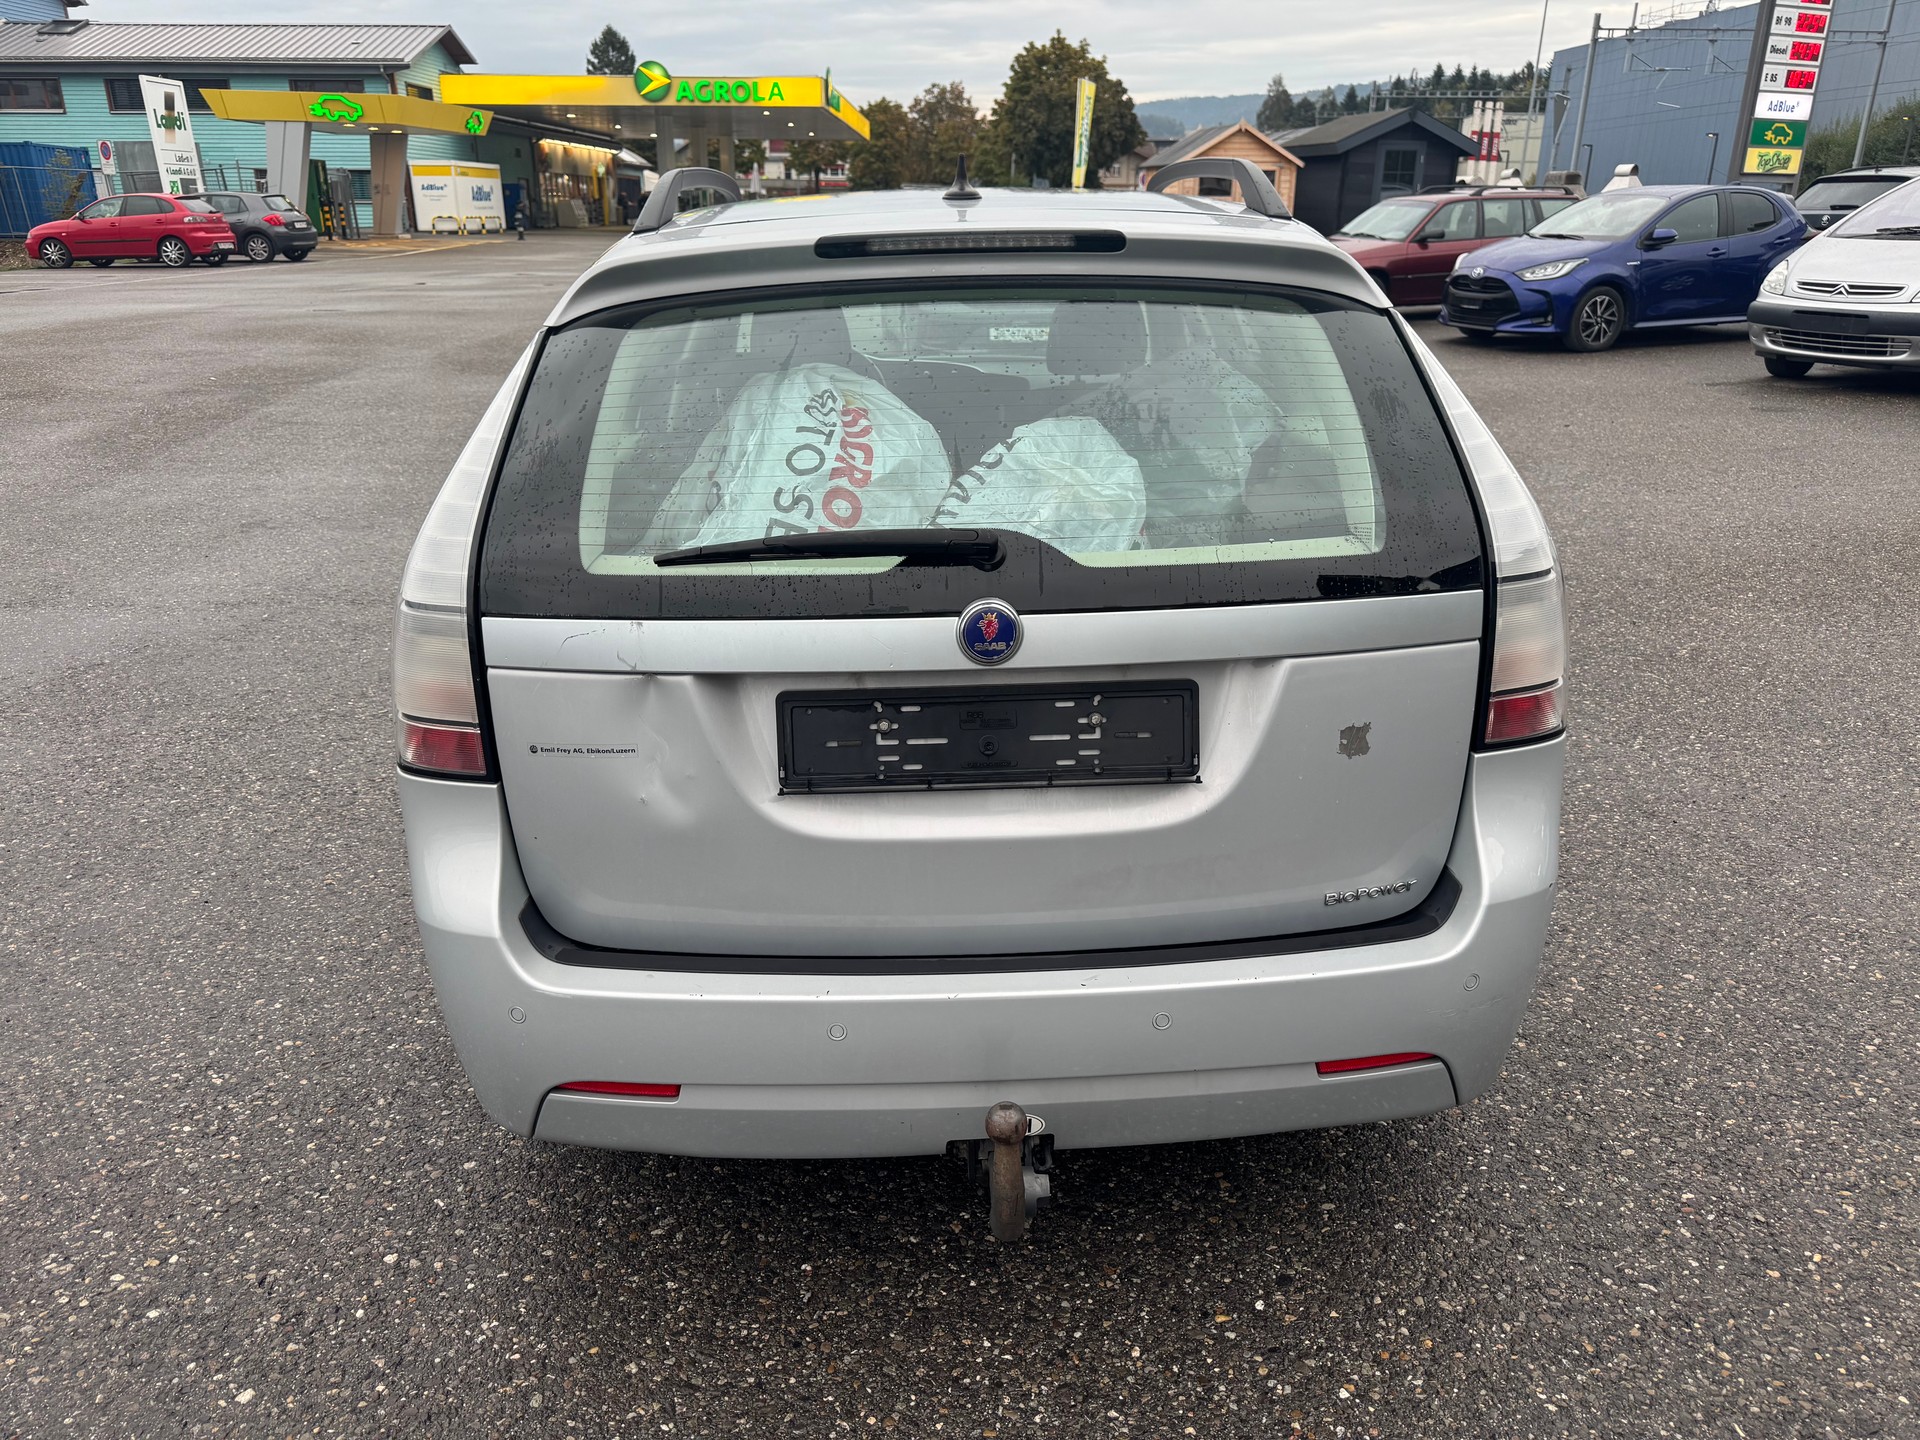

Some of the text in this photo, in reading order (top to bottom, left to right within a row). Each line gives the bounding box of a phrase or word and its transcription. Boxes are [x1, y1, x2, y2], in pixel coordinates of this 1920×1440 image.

[1784, 17, 1793, 26] 98
[1769, 44, 1788, 55] Diesel
[1764, 73, 1769, 82] E
[1769, 73, 1778, 83] 85
[676, 80, 785, 103] AGROLA
[974, 641, 1007, 651] SAAB
[556, 747, 571, 755] Frey
[572, 747, 585, 755] AG,
[1324, 878, 1418, 906] BioPower
